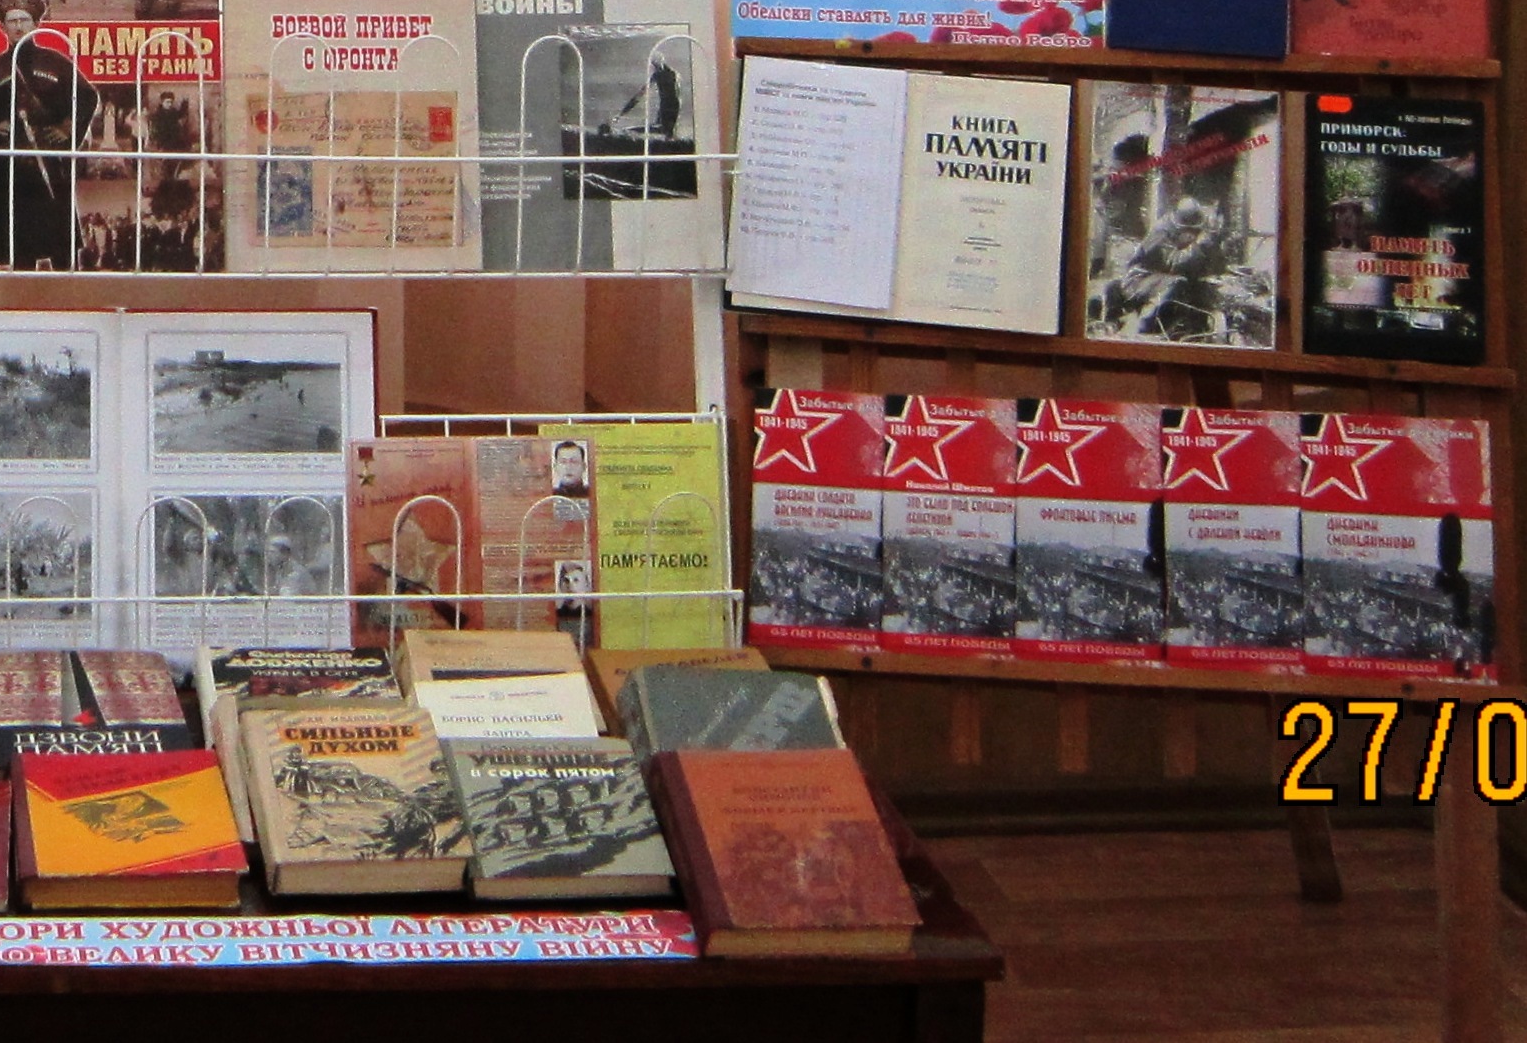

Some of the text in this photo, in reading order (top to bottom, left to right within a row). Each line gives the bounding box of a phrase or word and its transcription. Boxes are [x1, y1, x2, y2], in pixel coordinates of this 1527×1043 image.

[738, 3, 992, 29] Обеліски ставлять для живих!
[273, 15, 432, 39] БОЕВОЙ ПРИВЕТ
[69, 26, 213, 56] ПАМЯТЬ
[93, 58, 214, 77] БЕЗ ГРАНИЦ
[303, 48, 314, 70] С
[951, 115, 1019, 135] КНИГА
[1320, 122, 1408, 139] ПРИМОРСК:
[1320, 141, 1442, 158] ГОДЫ И СУДЬБЫ
[936, 161, 1032, 185] УКРАЇНИ
[799, 397, 855, 411] Забытые
[284, 725, 414, 740] СИЛЬНЫЕ
[309, 739, 399, 753] ДУХОМ
[488, 766, 615, 778] сорок пятом
[100, 916, 373, 941] ХУДОЖНЬОЇ
[390, 915, 655, 937] ЛІТЕРАТУРИ
[46, 945, 223, 964] ВЕЛИКУ
[240, 941, 520, 962] ВІТЧИЗНЯНУ
[539, 937, 672, 957] ВІЙНУ
